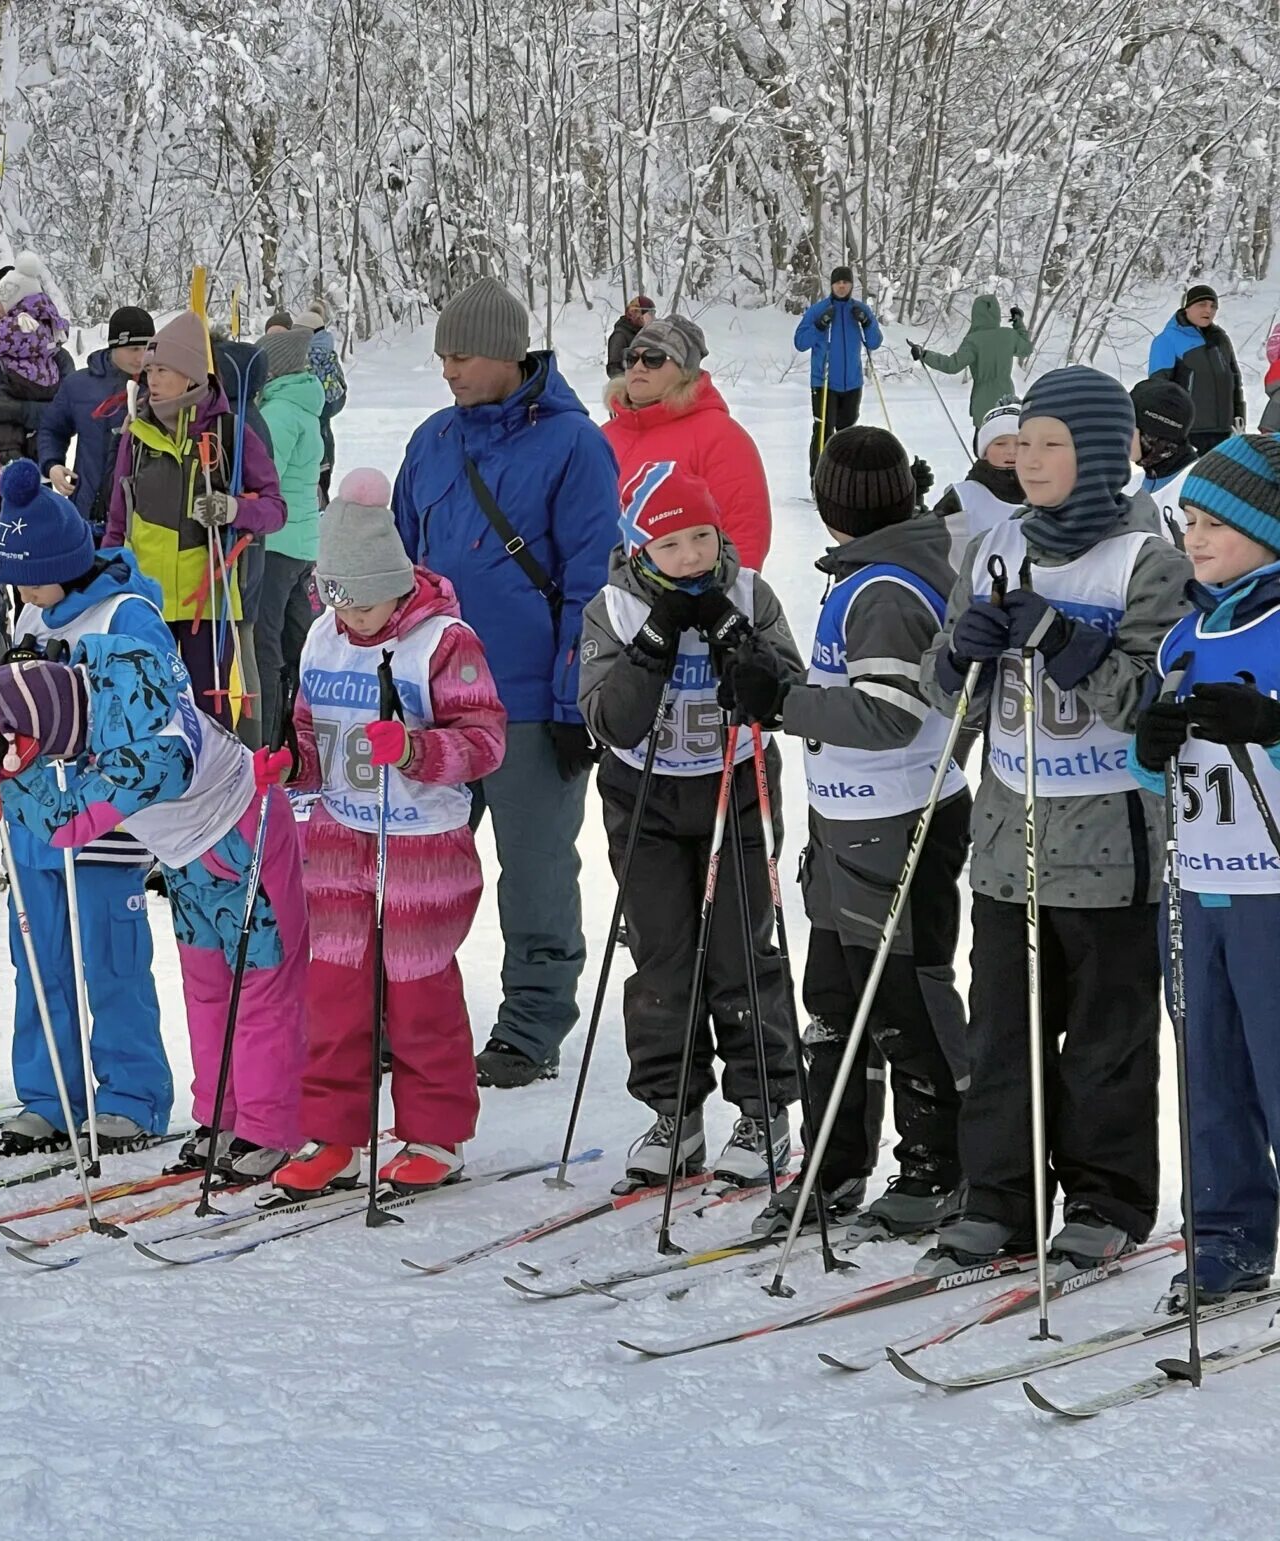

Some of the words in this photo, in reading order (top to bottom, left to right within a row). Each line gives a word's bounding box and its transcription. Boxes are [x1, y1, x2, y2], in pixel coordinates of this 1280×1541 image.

[648, 507, 683, 527] MADSHUS
[1177, 762, 1236, 825] 51
[935, 1266, 996, 1292] ATOMIC
[1061, 1266, 1105, 1296] ATOMIC
